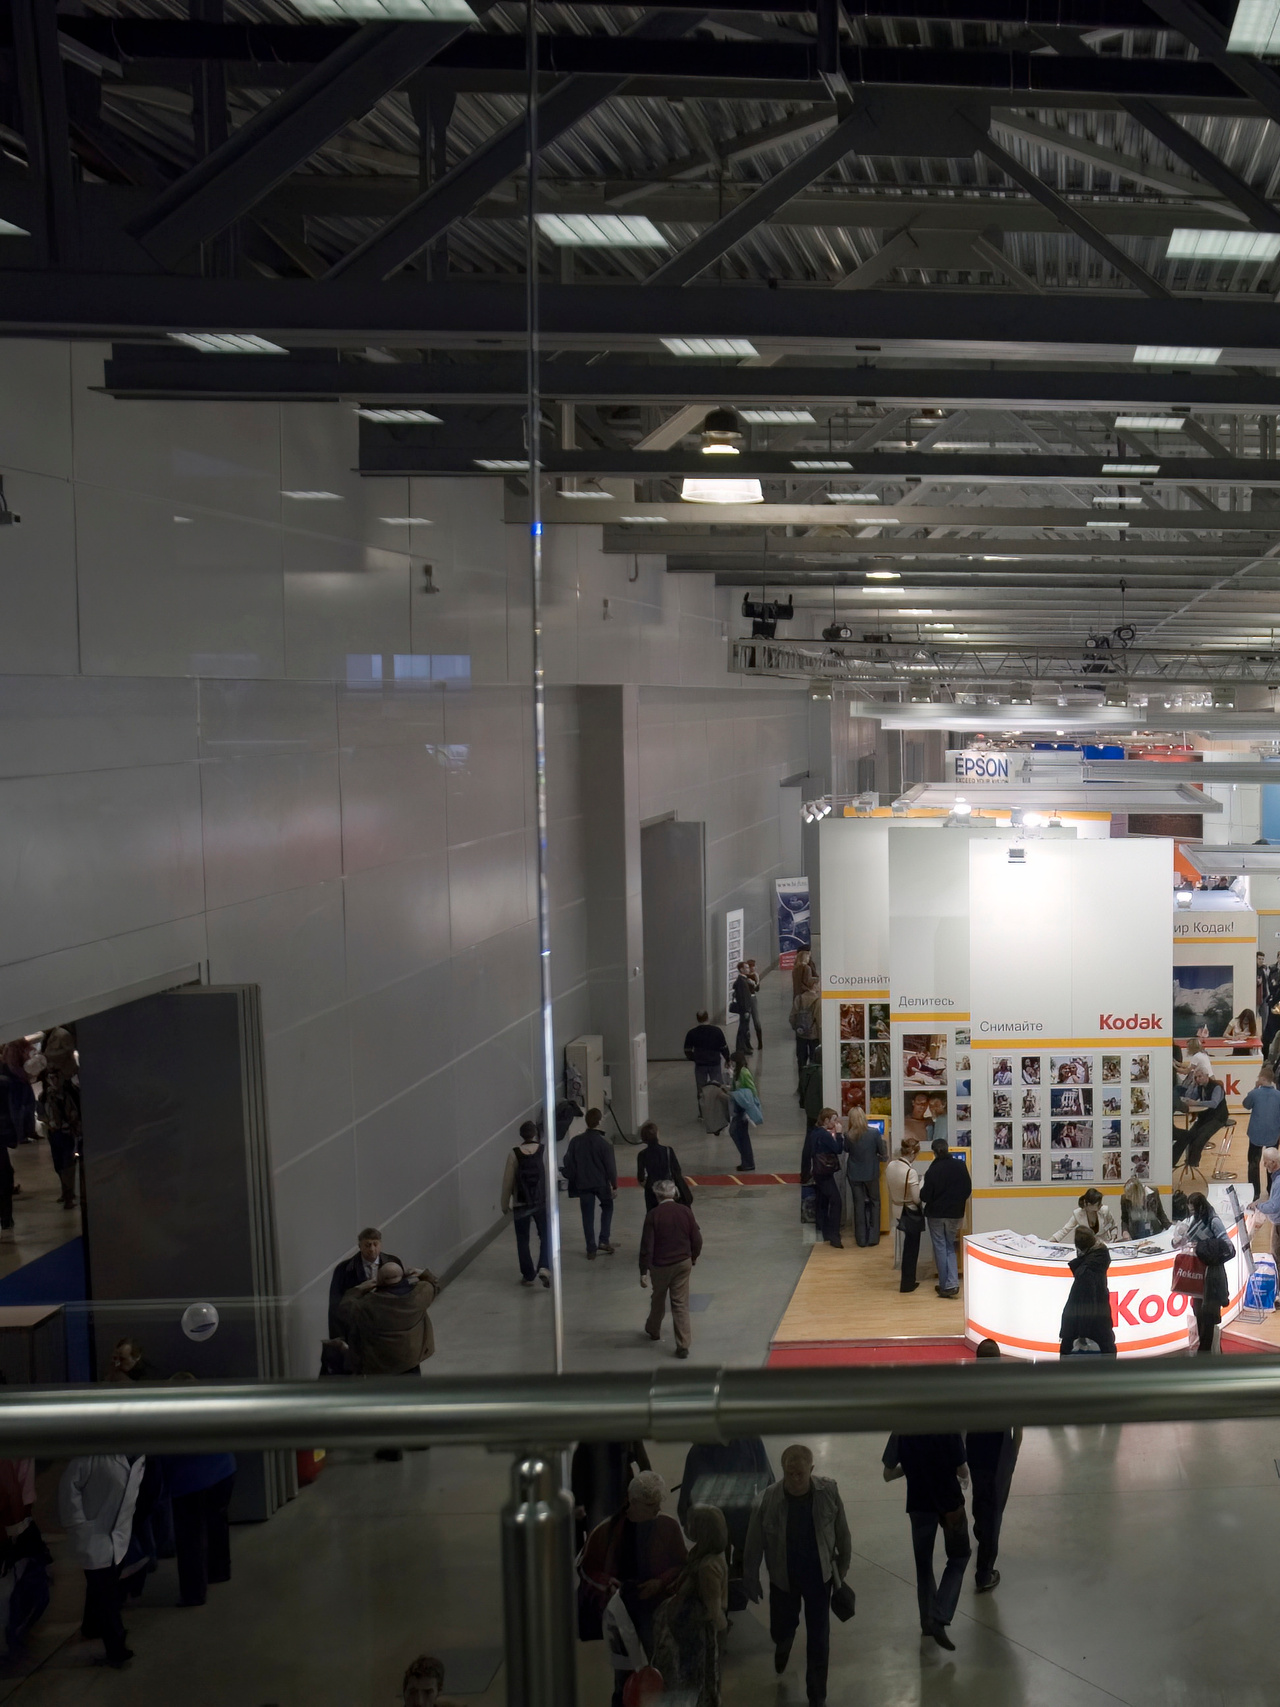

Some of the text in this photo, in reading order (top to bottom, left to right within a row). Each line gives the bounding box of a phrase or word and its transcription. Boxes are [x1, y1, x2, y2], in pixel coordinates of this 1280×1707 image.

[955, 757, 1009, 777] EPSON
[1193, 921, 1234, 934] Кодак!
[898, 996, 955, 1008] Делитесь
[979, 1020, 1043, 1032] Снимайте
[1100, 1013, 1163, 1030] Kodak
[1177, 1268, 1204, 1280] Rekam
